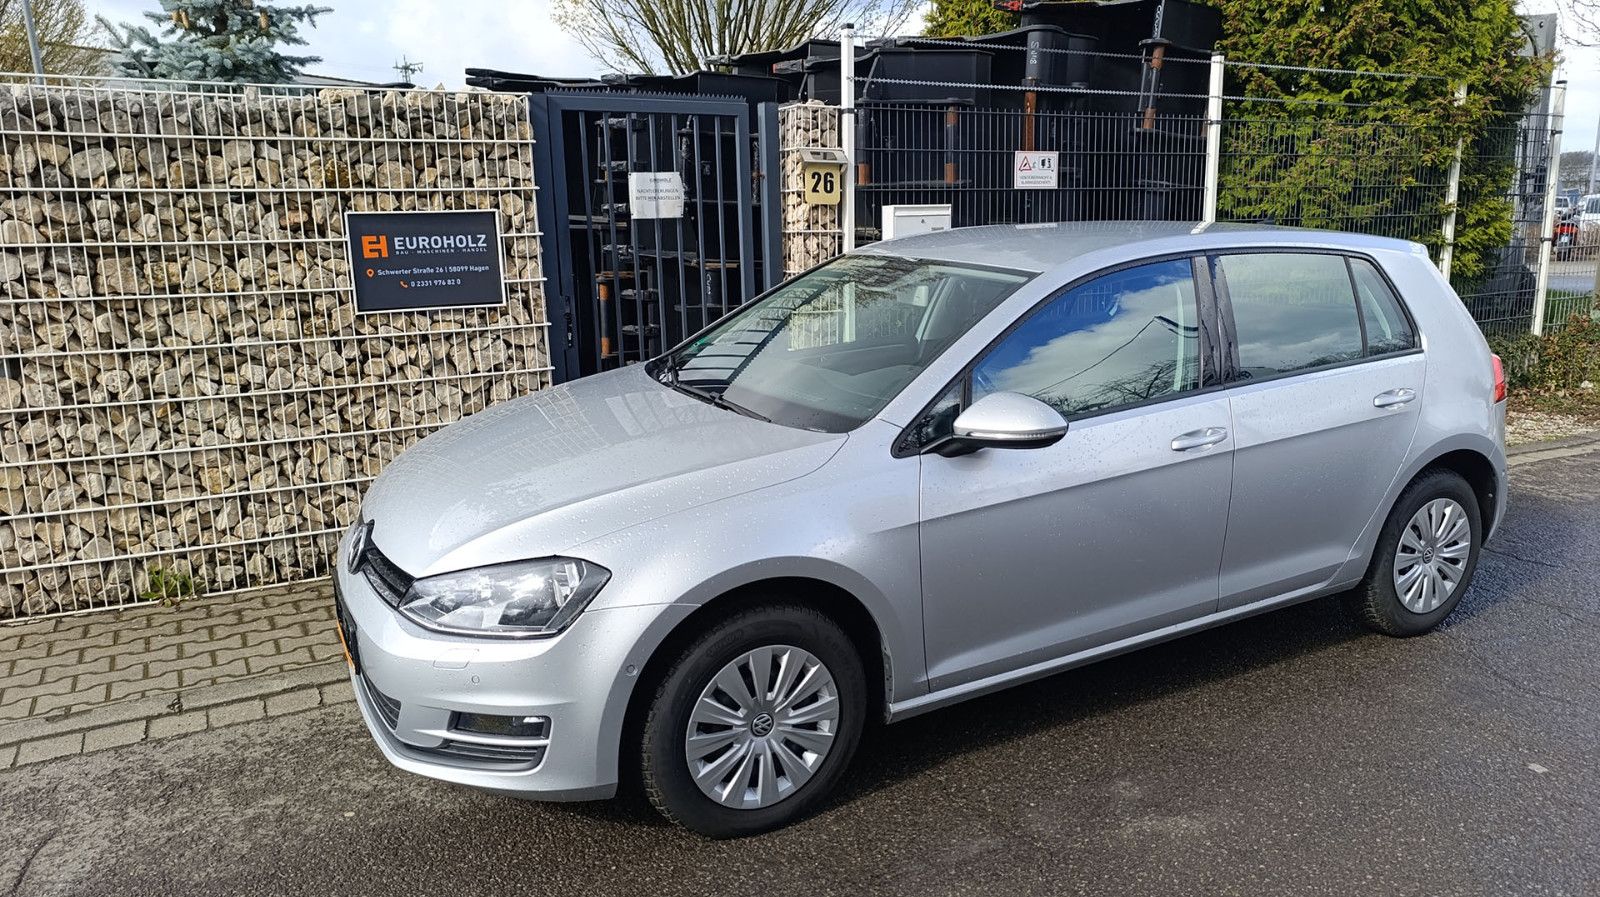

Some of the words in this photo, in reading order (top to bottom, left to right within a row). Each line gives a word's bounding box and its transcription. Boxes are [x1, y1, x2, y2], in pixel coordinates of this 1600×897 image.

[811, 172, 834, 194] 26
[394, 234, 487, 249] EUROHOLZ
[378, 268, 411, 276] Schwerter
[412, 267, 434, 275] Straße
[435, 266, 444, 274] 26
[449, 265, 469, 273] 58099
[470, 265, 489, 273] Hagen
[433, 279, 447, 287] 976
